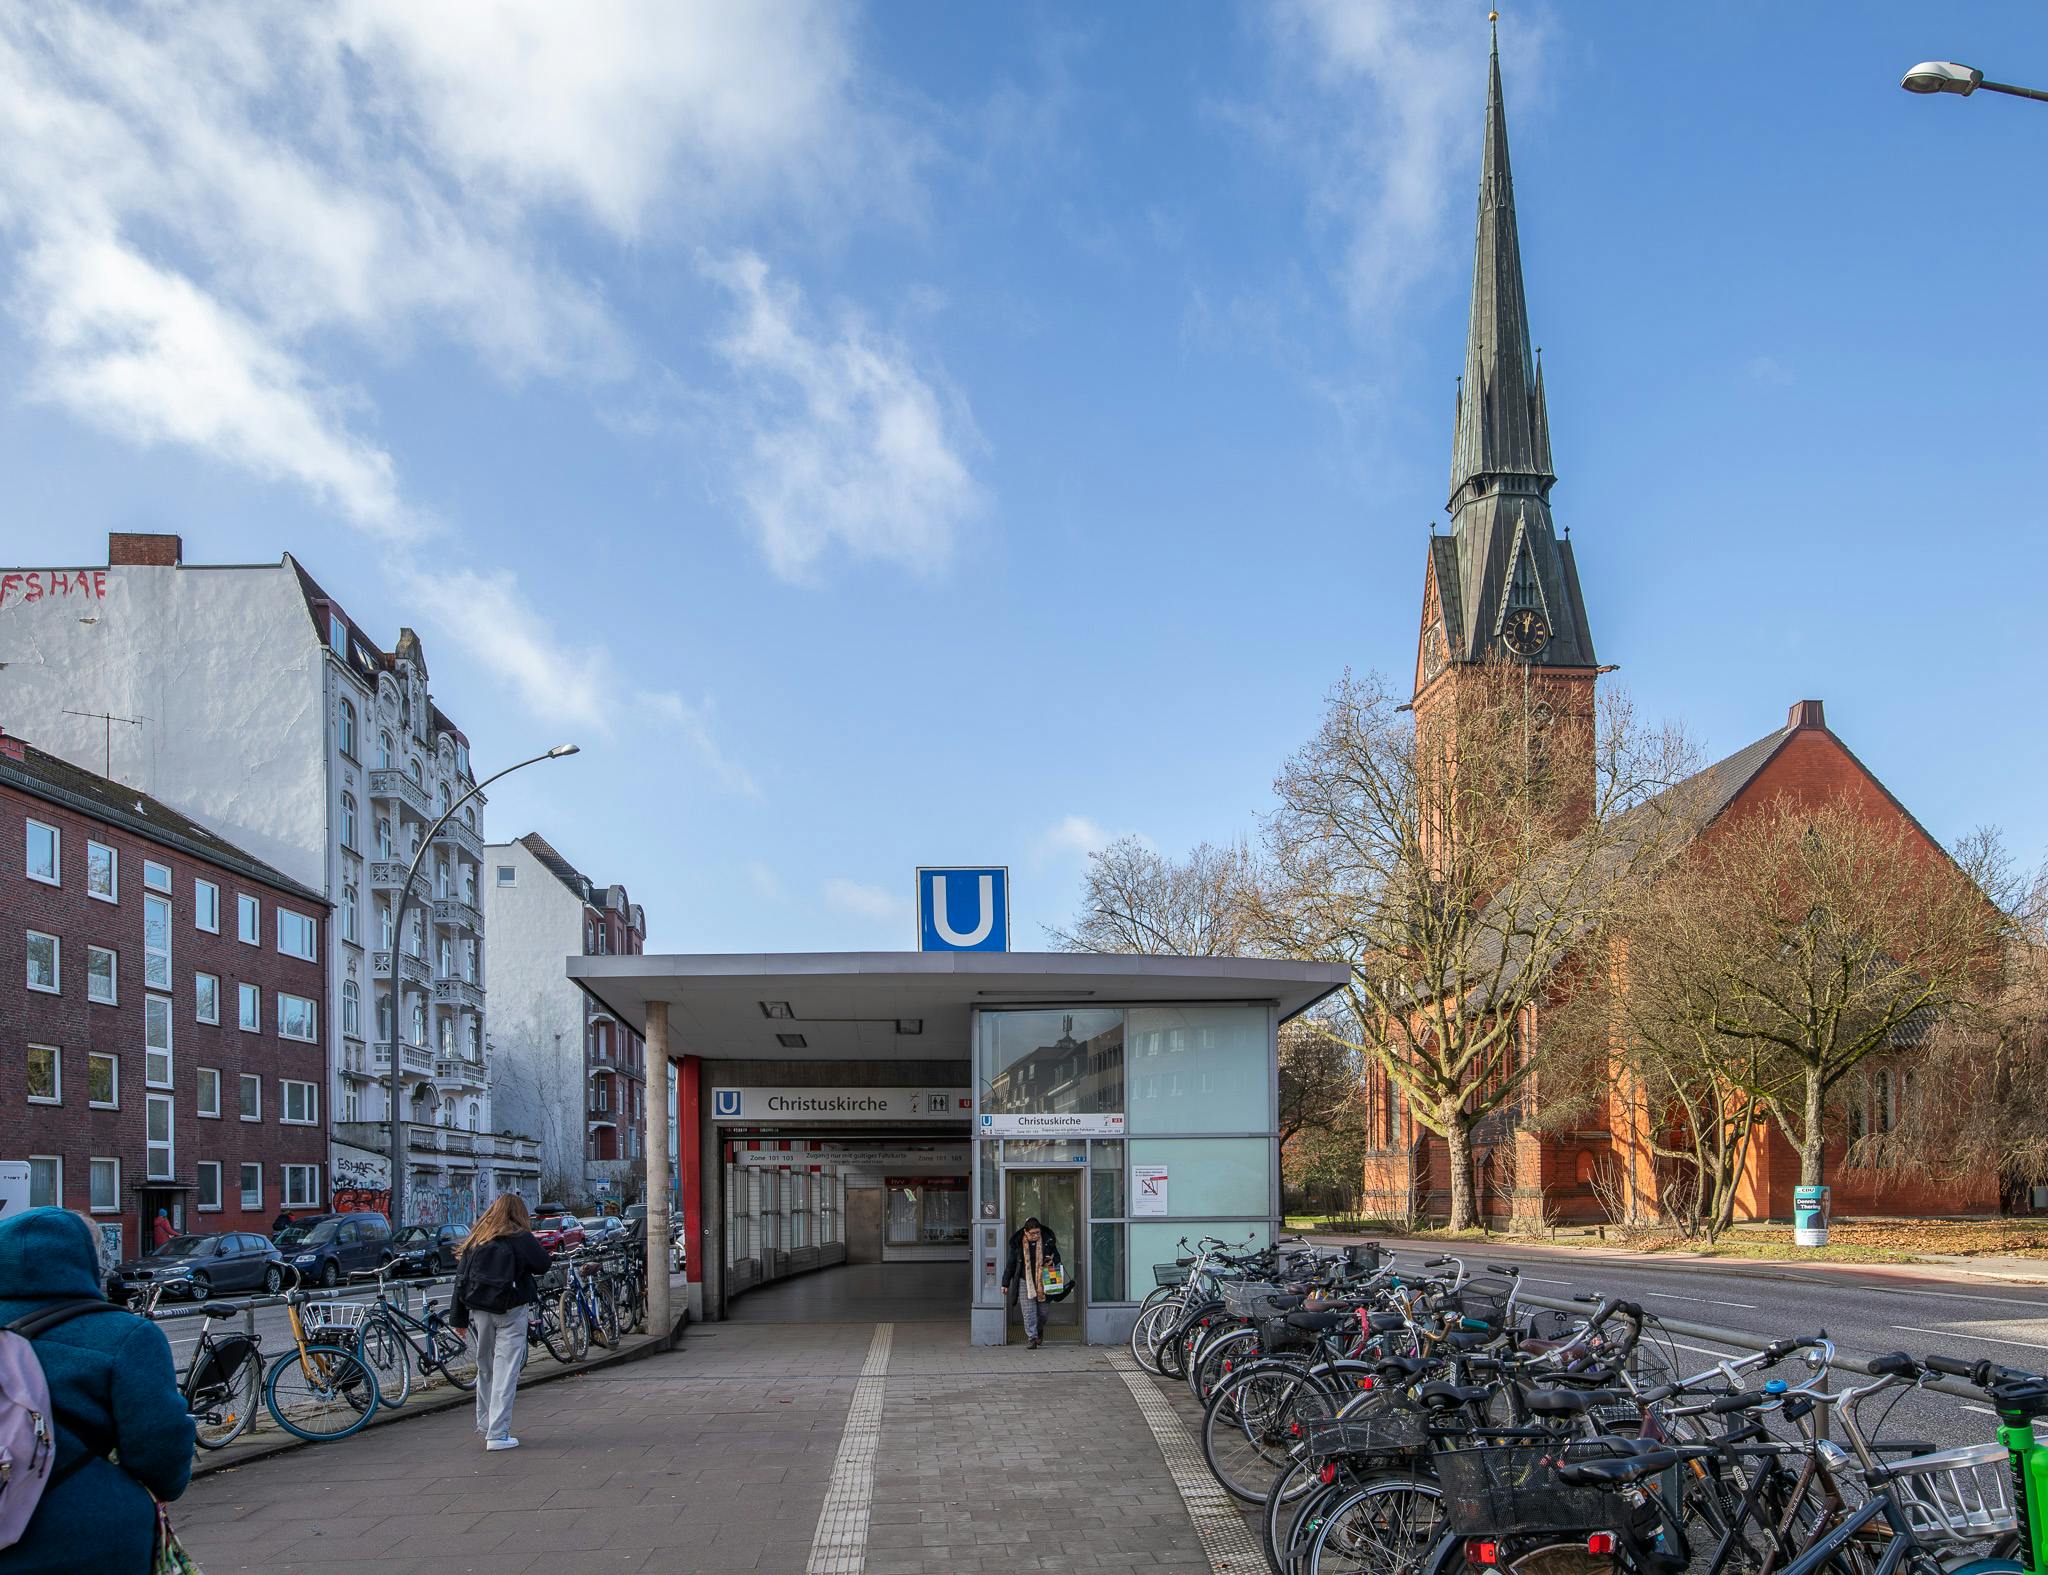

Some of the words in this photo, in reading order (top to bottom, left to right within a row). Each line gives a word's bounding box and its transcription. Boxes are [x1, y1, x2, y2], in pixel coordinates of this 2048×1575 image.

[932, 875, 994, 947] U
[718, 1092, 738, 1114] U
[767, 1096, 888, 1111] Christuskirche
[982, 1116, 991, 1126] U
[1018, 1116, 1081, 1126] Christuskirche
